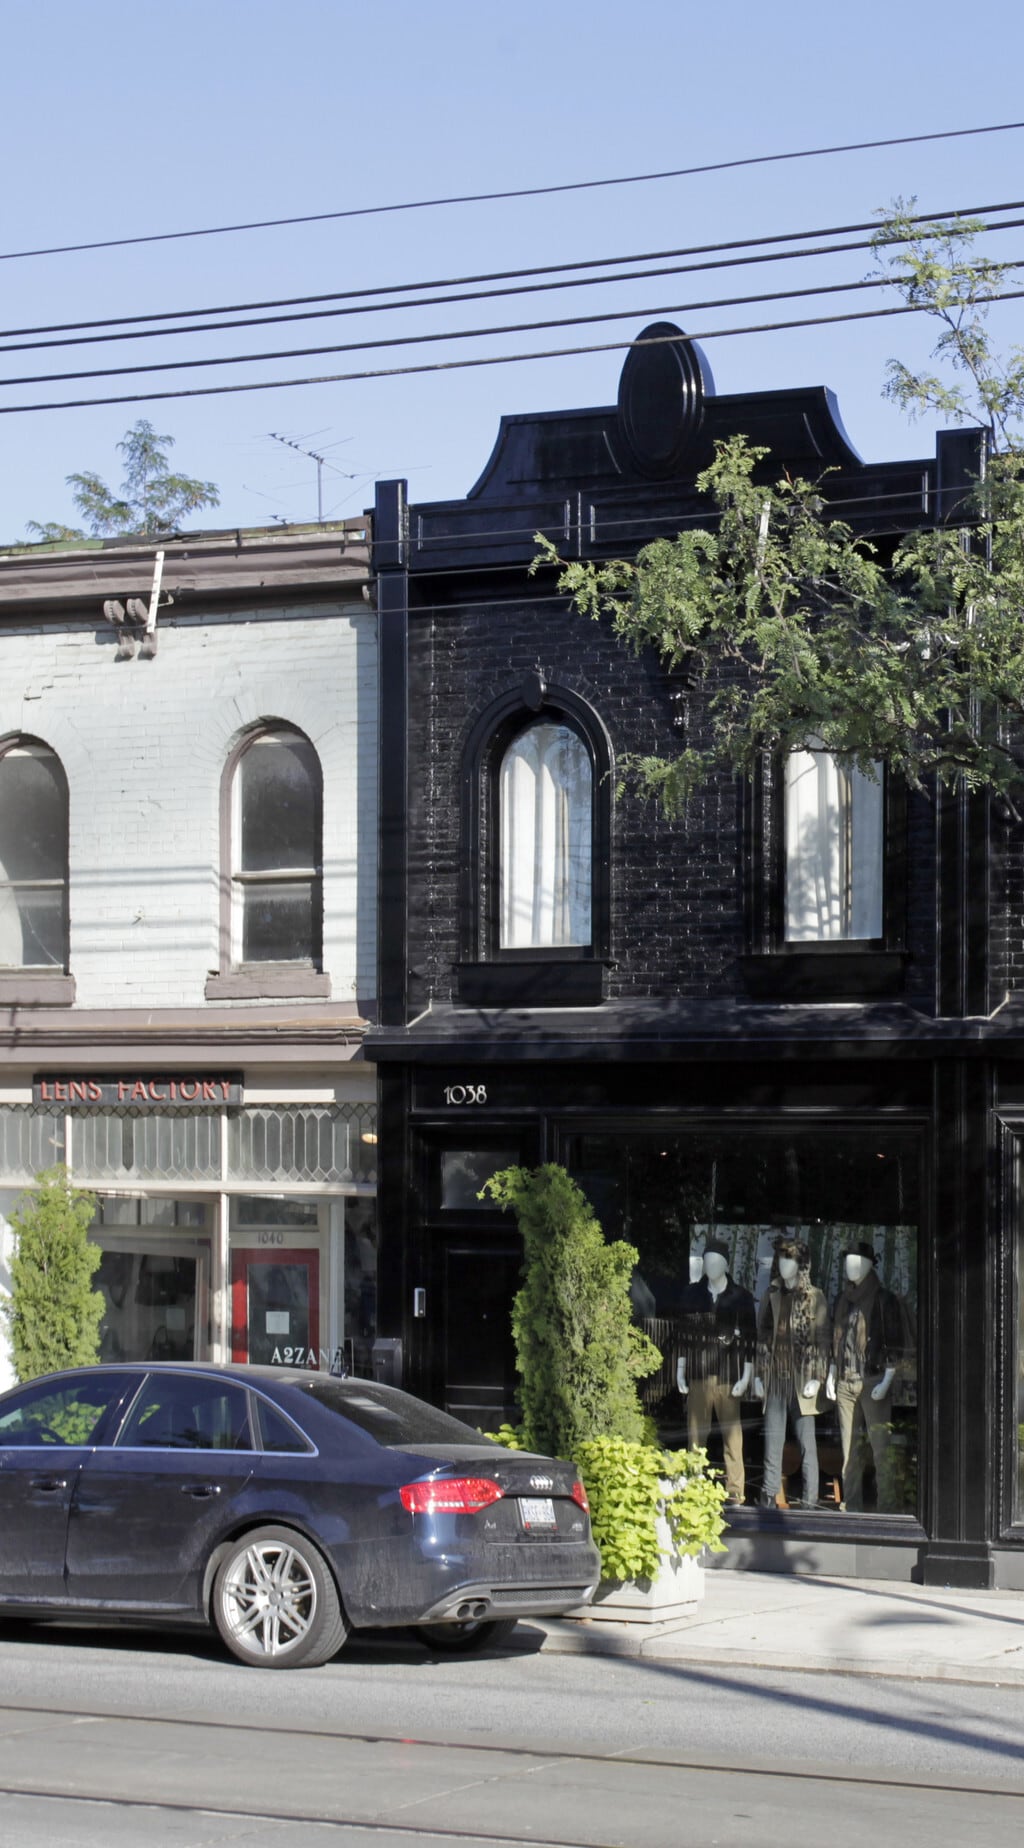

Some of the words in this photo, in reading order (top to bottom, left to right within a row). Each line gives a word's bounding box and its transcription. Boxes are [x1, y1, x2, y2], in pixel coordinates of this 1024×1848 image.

[40, 1079, 102, 1101] LENS
[117, 1077, 231, 1101] FACTORY
[443, 1084, 488, 1105] 1038
[257, 1231, 285, 1245] 1040
